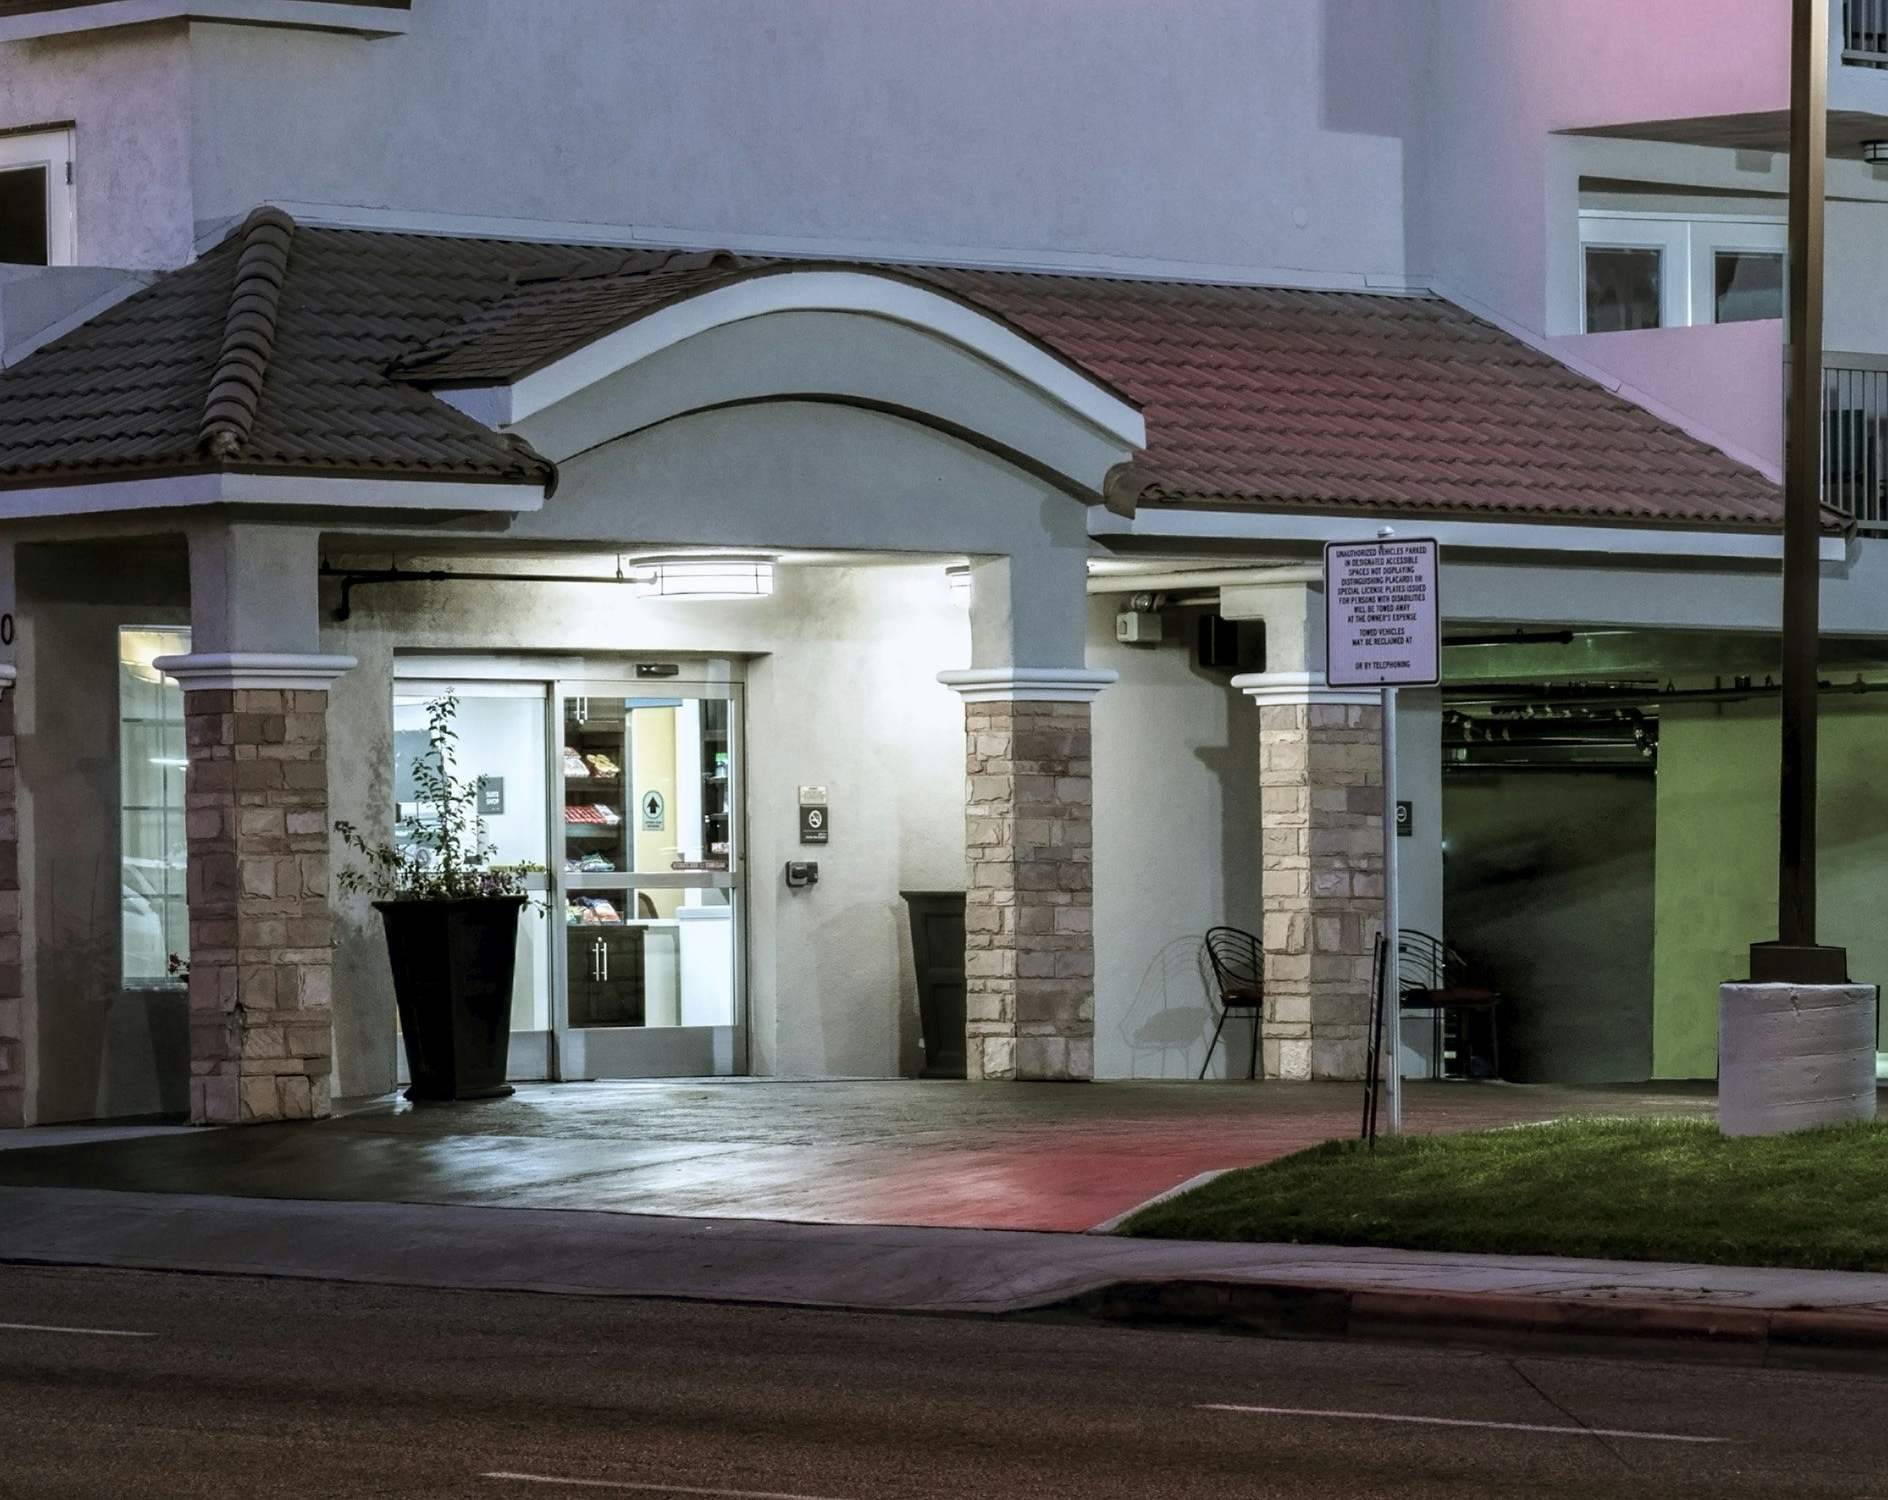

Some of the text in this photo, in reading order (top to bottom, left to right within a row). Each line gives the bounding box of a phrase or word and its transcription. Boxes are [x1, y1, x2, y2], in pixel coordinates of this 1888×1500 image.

[1336, 546, 1426, 557] UNAUTHORIZED VEHICLES PARKED
[1352, 558, 1384, 566] DESIGNATED
[1386, 556, 1418, 564] ACCESSIBLE
[1348, 566, 1414, 576] SPACES NOT DISPLAYING
[1341, 576, 1384, 586] DISTINGUISHING
[1385, 576, 1413, 584] PLACARDS
[1337, 584, 1426, 595] SPECIAL LICENSE PLATES ISSUED
[1339, 596, 1349, 604] FOR
[1351, 595, 1376, 604] PERSONS
[1392, 594, 1425, 602] DISABILITIES
[1368, 605, 1375, 613] BE
[1376, 604, 1394, 612] TOWED
[1355, 615, 1366, 623] THE
[1367, 614, 1391, 622] OWNER'S
[1393, 613, 1417, 621] EXPENSE
[1379, 627, 1405, 635] VEHICLES
[1365, 638, 1372, 646] BE
[1374, 637, 1404, 645] RECLAIMED
[1406, 636, 1412, 644] AT
[1355, 661, 1410, 670] OR BY TELEPHONING
